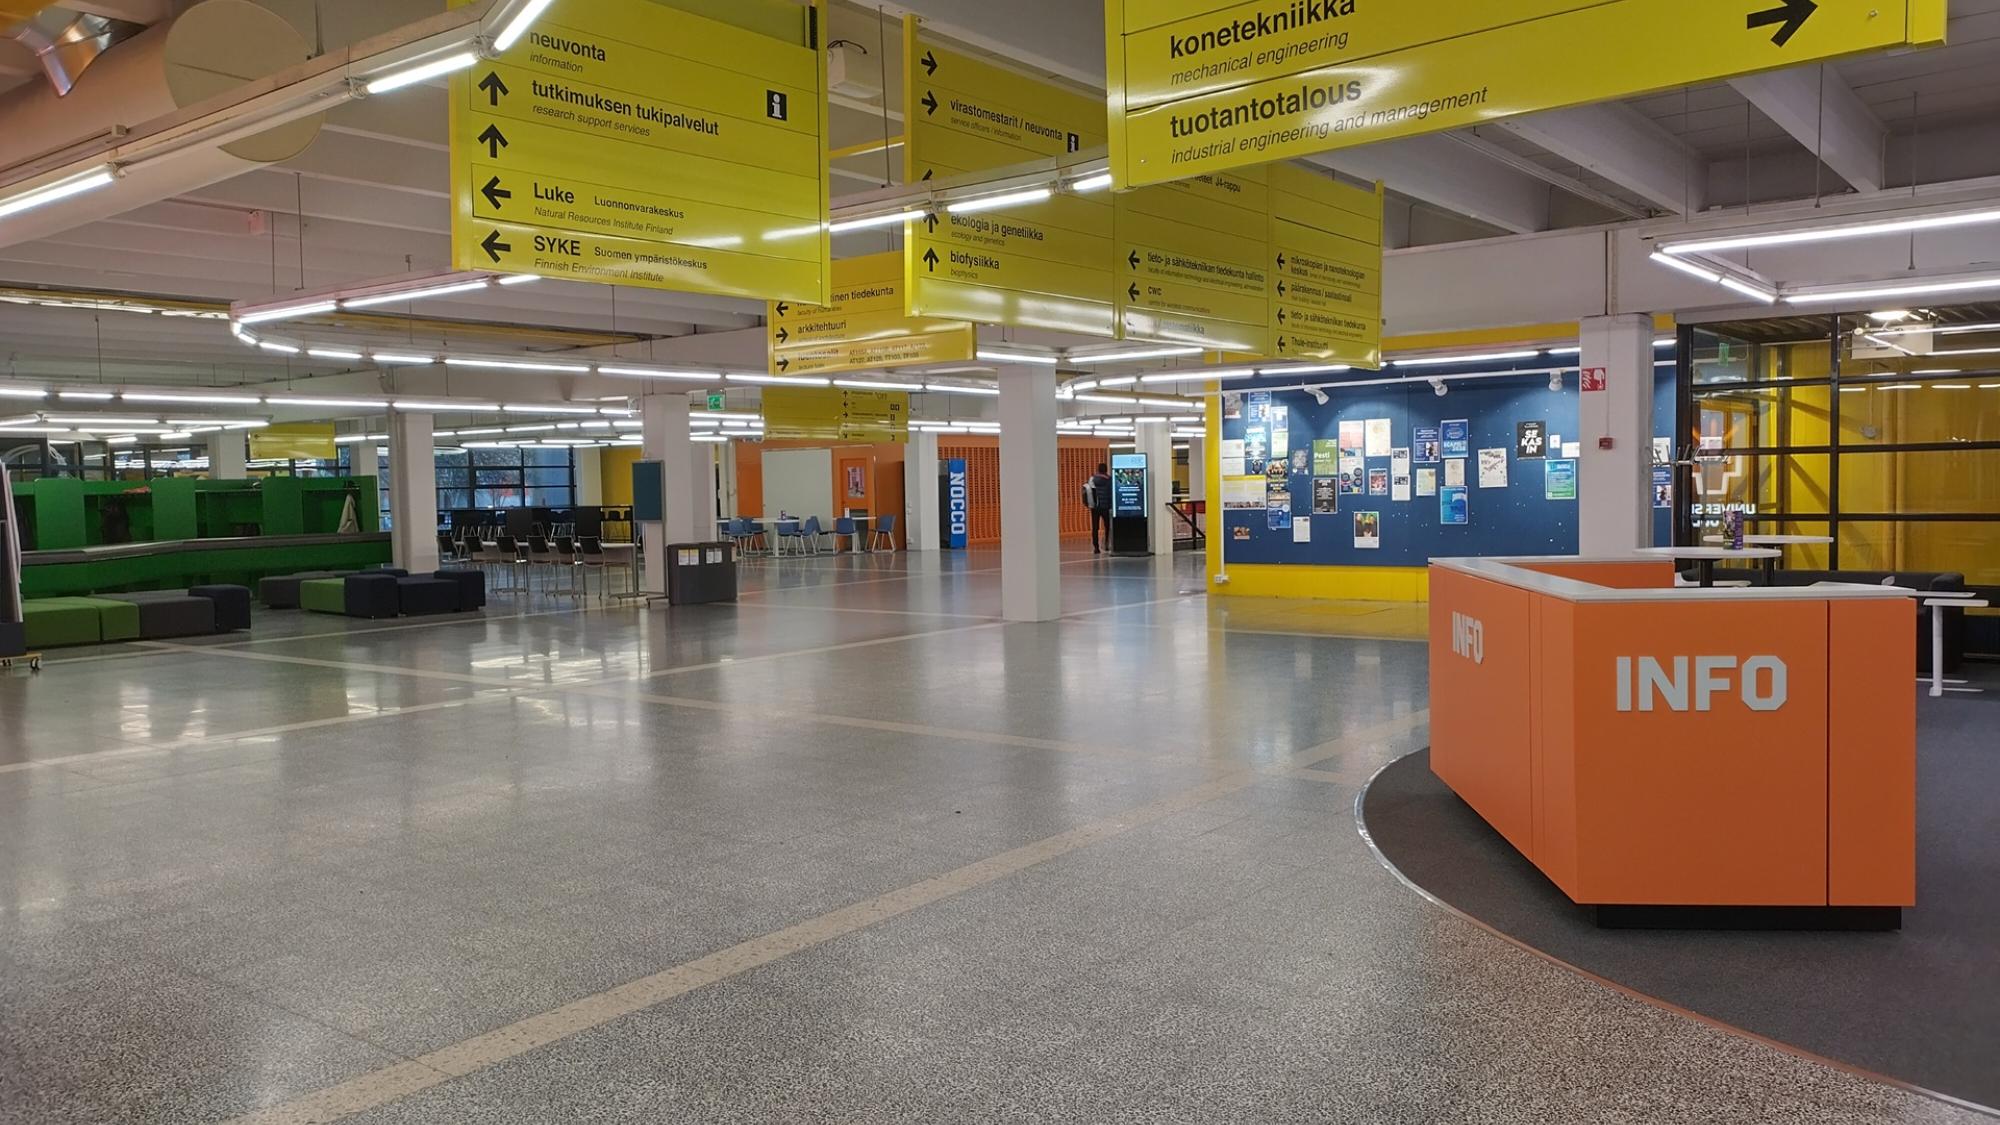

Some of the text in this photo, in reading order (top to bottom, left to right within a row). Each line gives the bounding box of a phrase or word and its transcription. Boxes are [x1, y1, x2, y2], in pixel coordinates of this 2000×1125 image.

[1170, 0, 1355, 59] konetekniikka
[530, 31, 606, 61] neuvonta
[1171, 31, 1349, 86] mechanical engineering
[530, 52, 583, 73] information
[532, 80, 719, 136] tutkimuksen tukipalvelut
[533, 104, 650, 136] research support services
[950, 100, 1018, 128] virastomestarit
[1025, 121, 1063, 140] neuvonta
[1170, 80, 1362, 138] tuotantotalous
[1171, 86, 1488, 165] industrial engineering and management
[533, 182, 684, 219] Luke Luonnonvarakeskus
[534, 206, 673, 236] Natural Resources Institute Finland
[950, 215, 1044, 241] ekologia ja genetiikka
[534, 235, 708, 270] SYKE Suomen ympäristökeskus
[950, 250, 1000, 270] biofysiikka
[534, 258, 664, 282] Finnish Environment Institute
[851, 286, 894, 301] tiedekunta
[797, 320, 847, 334] arkkitehtuuri
[1521, 437, 1542, 447] KAS
[1524, 429, 1538, 439] SE
[1526, 445, 1537, 454] IN
[950, 472, 965, 535] NOCCO
[1452, 610, 1484, 664] INFO
[1616, 655, 1787, 711] INFO
